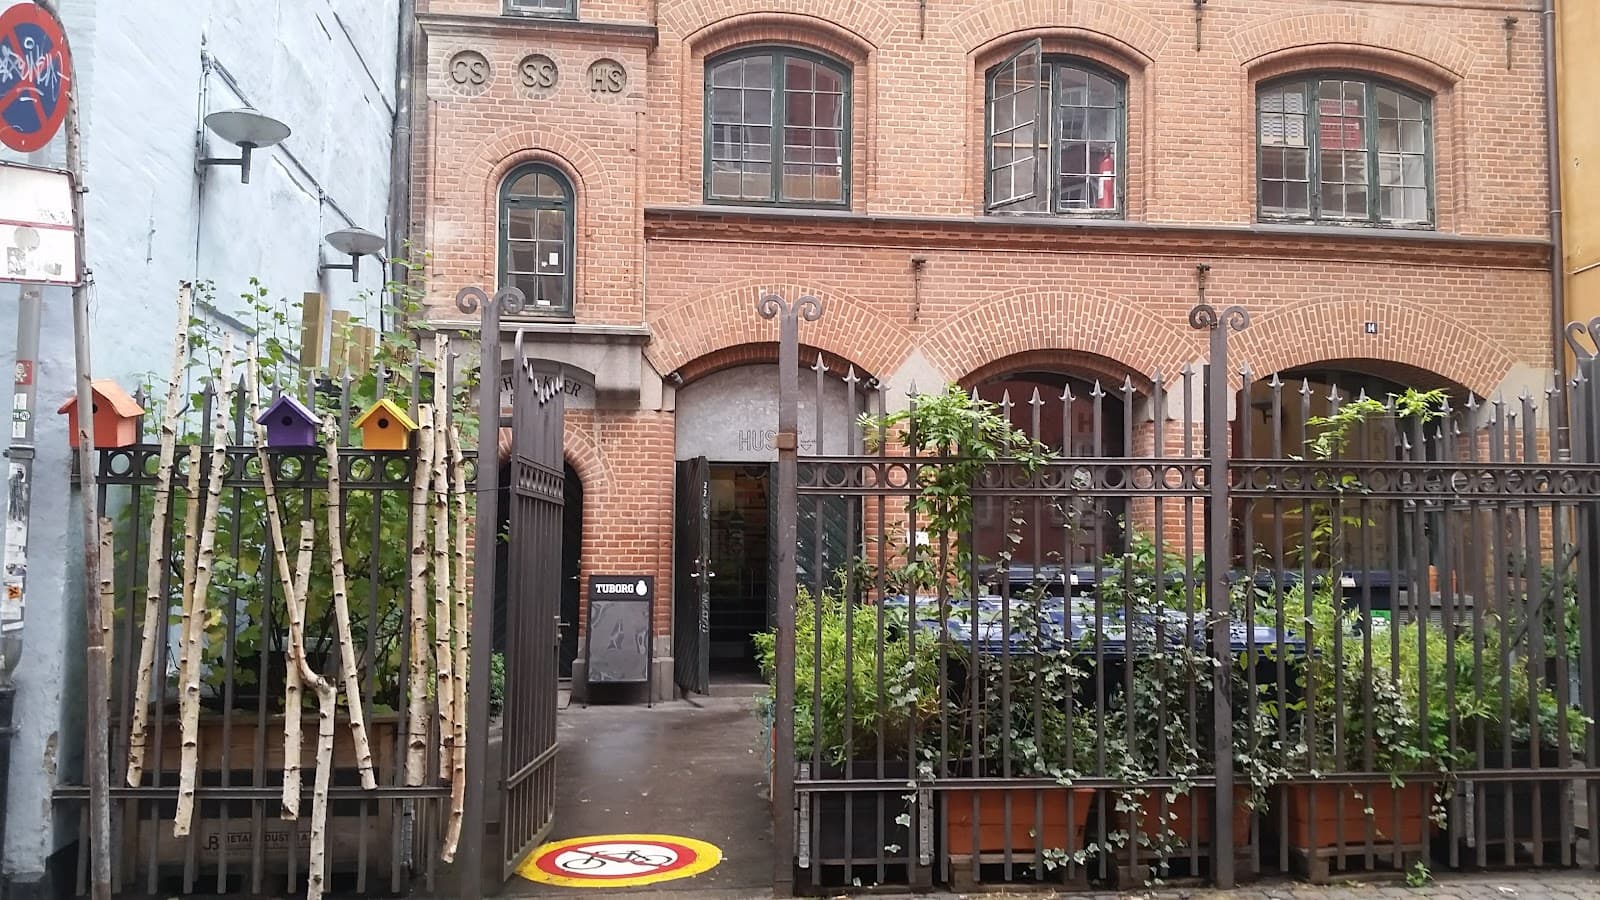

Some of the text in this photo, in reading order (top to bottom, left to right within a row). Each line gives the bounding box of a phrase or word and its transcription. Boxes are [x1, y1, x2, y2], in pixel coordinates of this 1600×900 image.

[450, 61, 486, 85] CS
[521, 63, 555, 88] SS
[590, 67, 624, 93] HS
[595, 583, 634, 594] TUBORG
